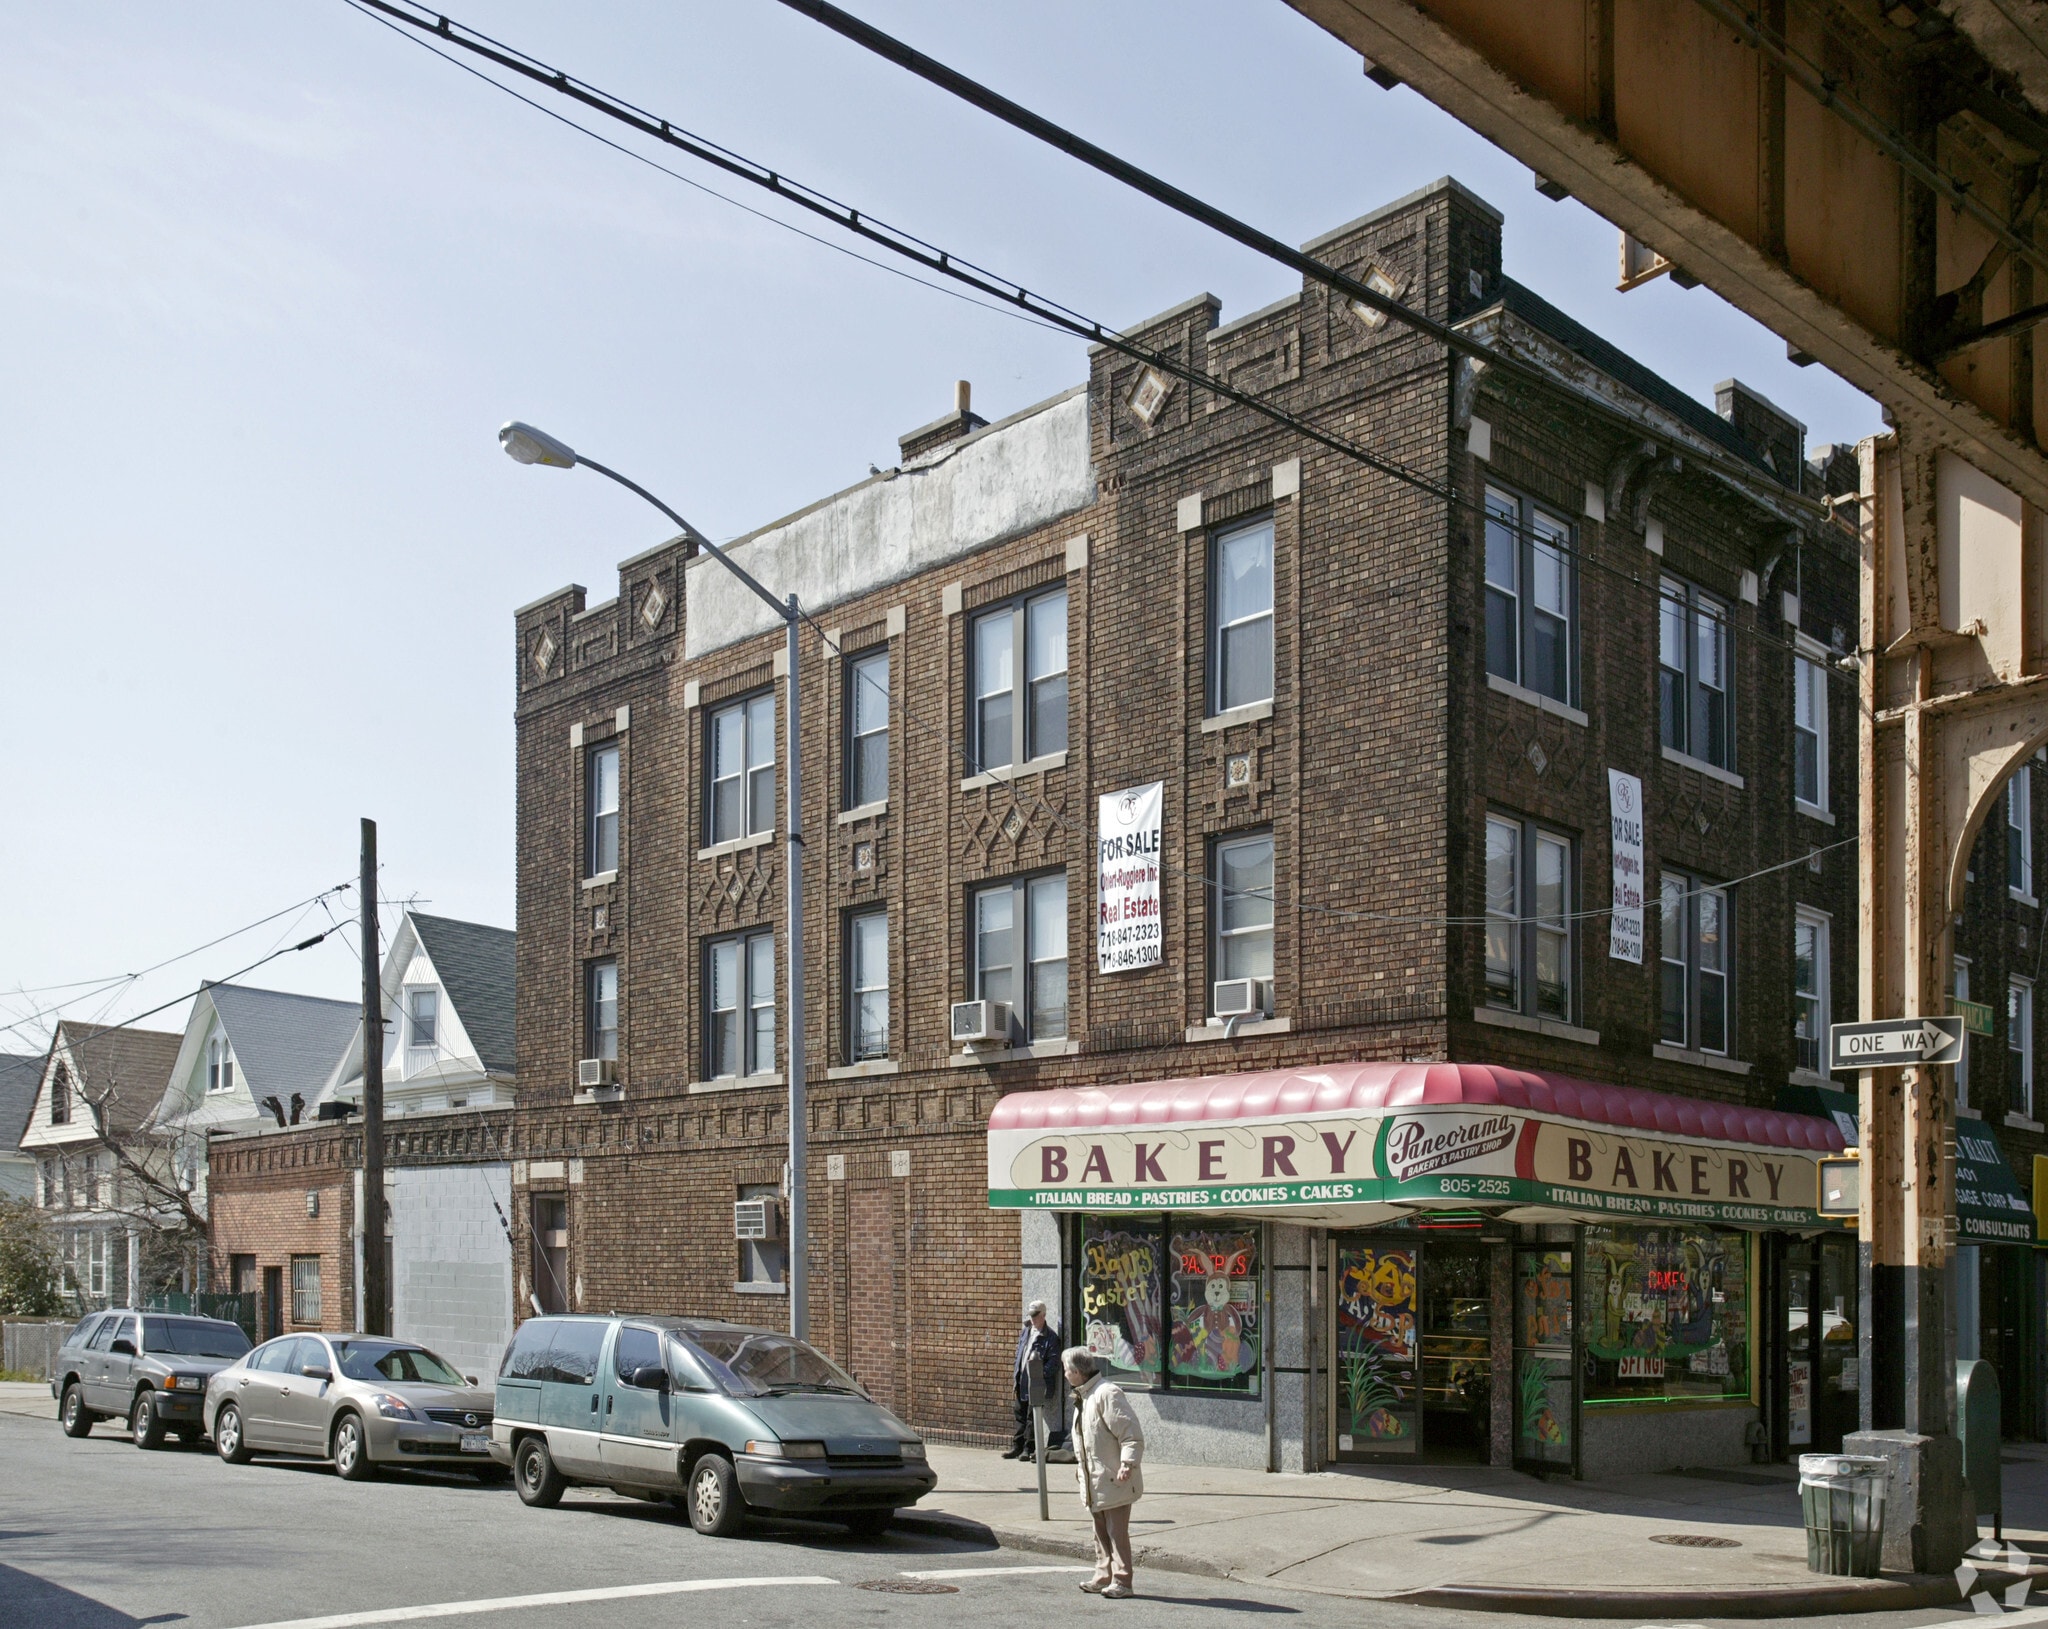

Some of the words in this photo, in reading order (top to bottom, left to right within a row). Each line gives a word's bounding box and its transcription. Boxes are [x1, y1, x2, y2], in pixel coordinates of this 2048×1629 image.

[1101, 836, 1123, 863] FOR
[1126, 829, 1159, 856] SALE
[1623, 819, 1640, 847] SALE
[1101, 898, 1121, 925] Real
[1123, 894, 1159, 920] Estate
[1101, 922, 1159, 948] 718-847-2323
[1101, 945, 1159, 969] 718-846-1300
[1850, 1035, 1885, 1053] ONE
[1902, 1031, 1941, 1049] WAY
[1388, 1114, 1509, 1165] Paneorama
[1960, 1135, 2001, 1165] REALTY
[1040, 1130, 1357, 1183] BAKERY
[1407, 1156, 1441, 1177] BAKERY
[1441, 1154, 1448, 1166] &
[1448, 1143, 1481, 1163] PASTRY
[1481, 1138, 1503, 1153] SHOP
[1567, 1137, 1784, 1200] BAKERY
[1035, 1191, 1083, 1205] ITALIAN
[1086, 1191, 1132, 1205] BREAD
[1141, 1190, 1210, 1205] PASTRIES
[1220, 1186, 1288, 1203] COOKIES
[1300, 1183, 1354, 1200] CAKES
[1440, 1178, 1511, 1195] 805-2525
[1552, 1188, 1603, 1208] ITALIAN
[1605, 1195, 1651, 1213] BREAD
[1658, 1201, 1716, 1218] PASTRIES
[1721, 1205, 1769, 1221] COOKIES
[1773, 1209, 1808, 1224] CAKES
[1965, 1218, 2030, 1239] CONSULTANTS
[1088, 1245, 1153, 1282] Happy
[1083, 1281, 1149, 1315] Easter
